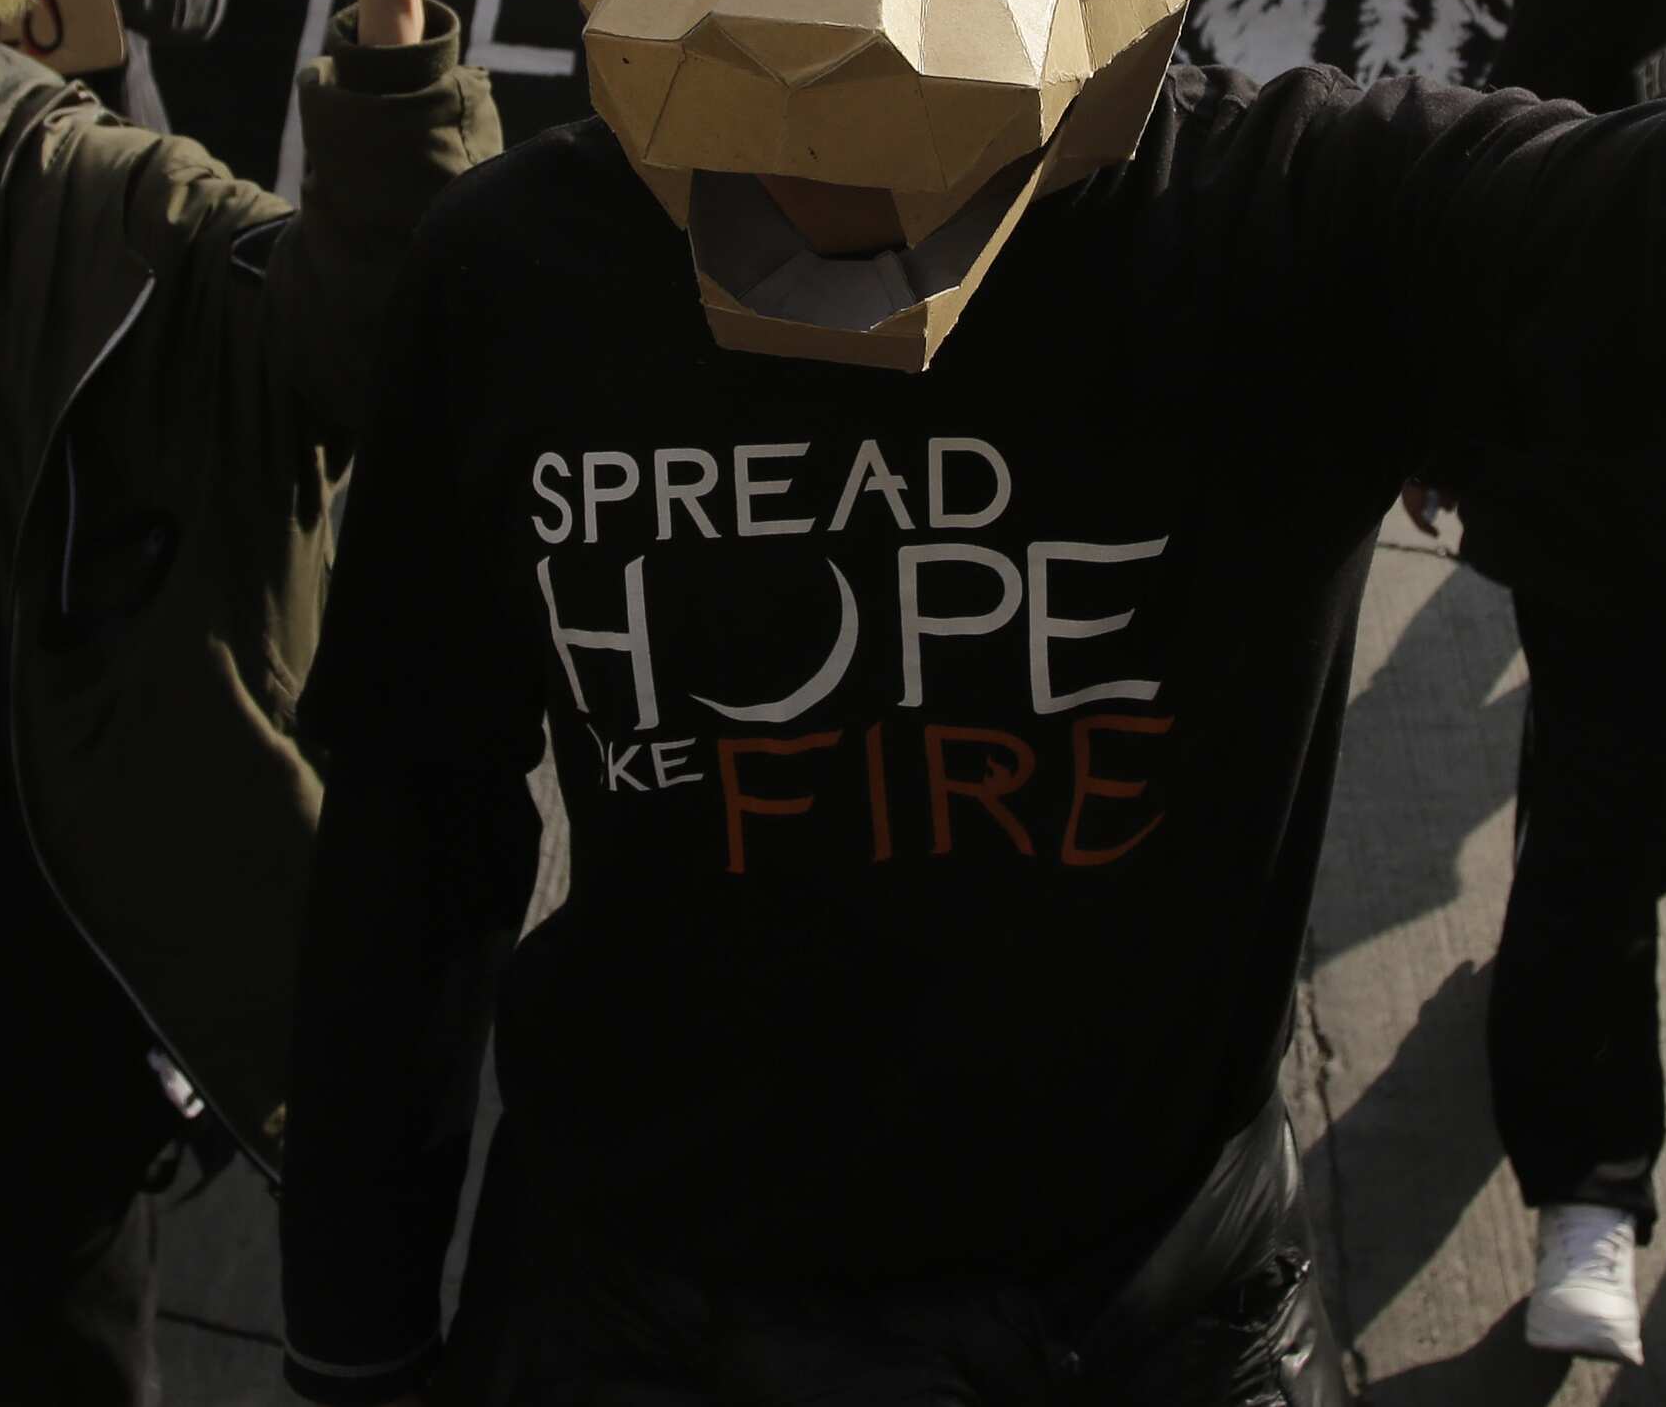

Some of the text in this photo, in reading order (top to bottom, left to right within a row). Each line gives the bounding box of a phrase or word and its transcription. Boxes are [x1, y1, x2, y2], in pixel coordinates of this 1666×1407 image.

[531, 437, 1013, 545] SPREAD
[588, 714, 1175, 874] KE FIRE
